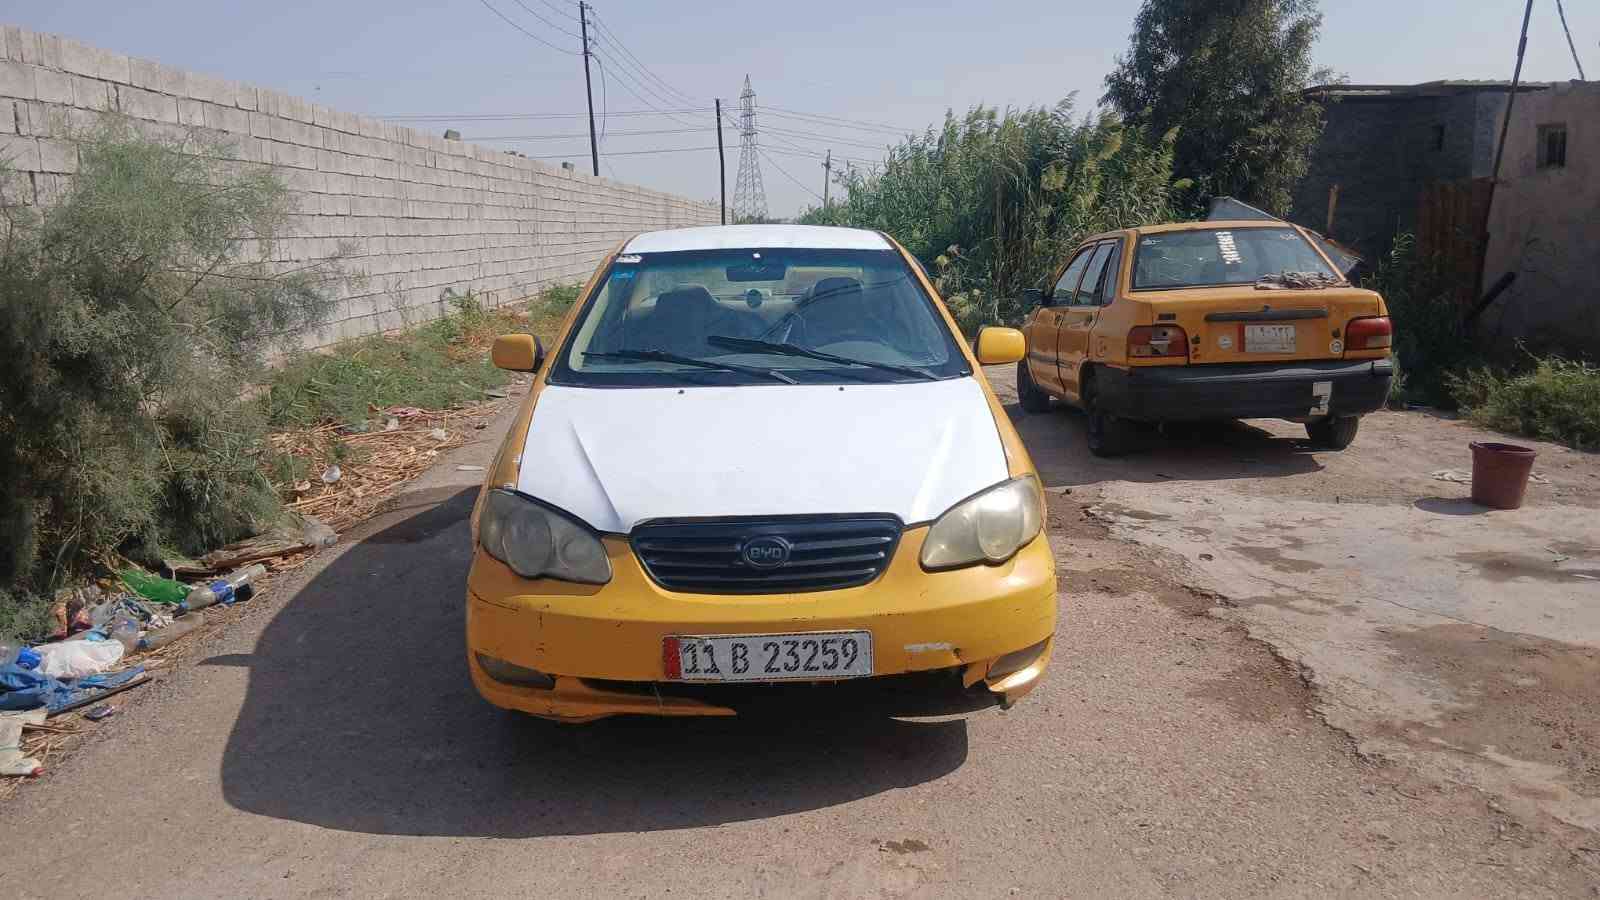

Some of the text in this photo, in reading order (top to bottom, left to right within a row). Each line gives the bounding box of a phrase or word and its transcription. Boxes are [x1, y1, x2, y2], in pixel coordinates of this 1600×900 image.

[751, 547, 783, 559] BYD
[684, 638, 858, 674] 11 B 23259
